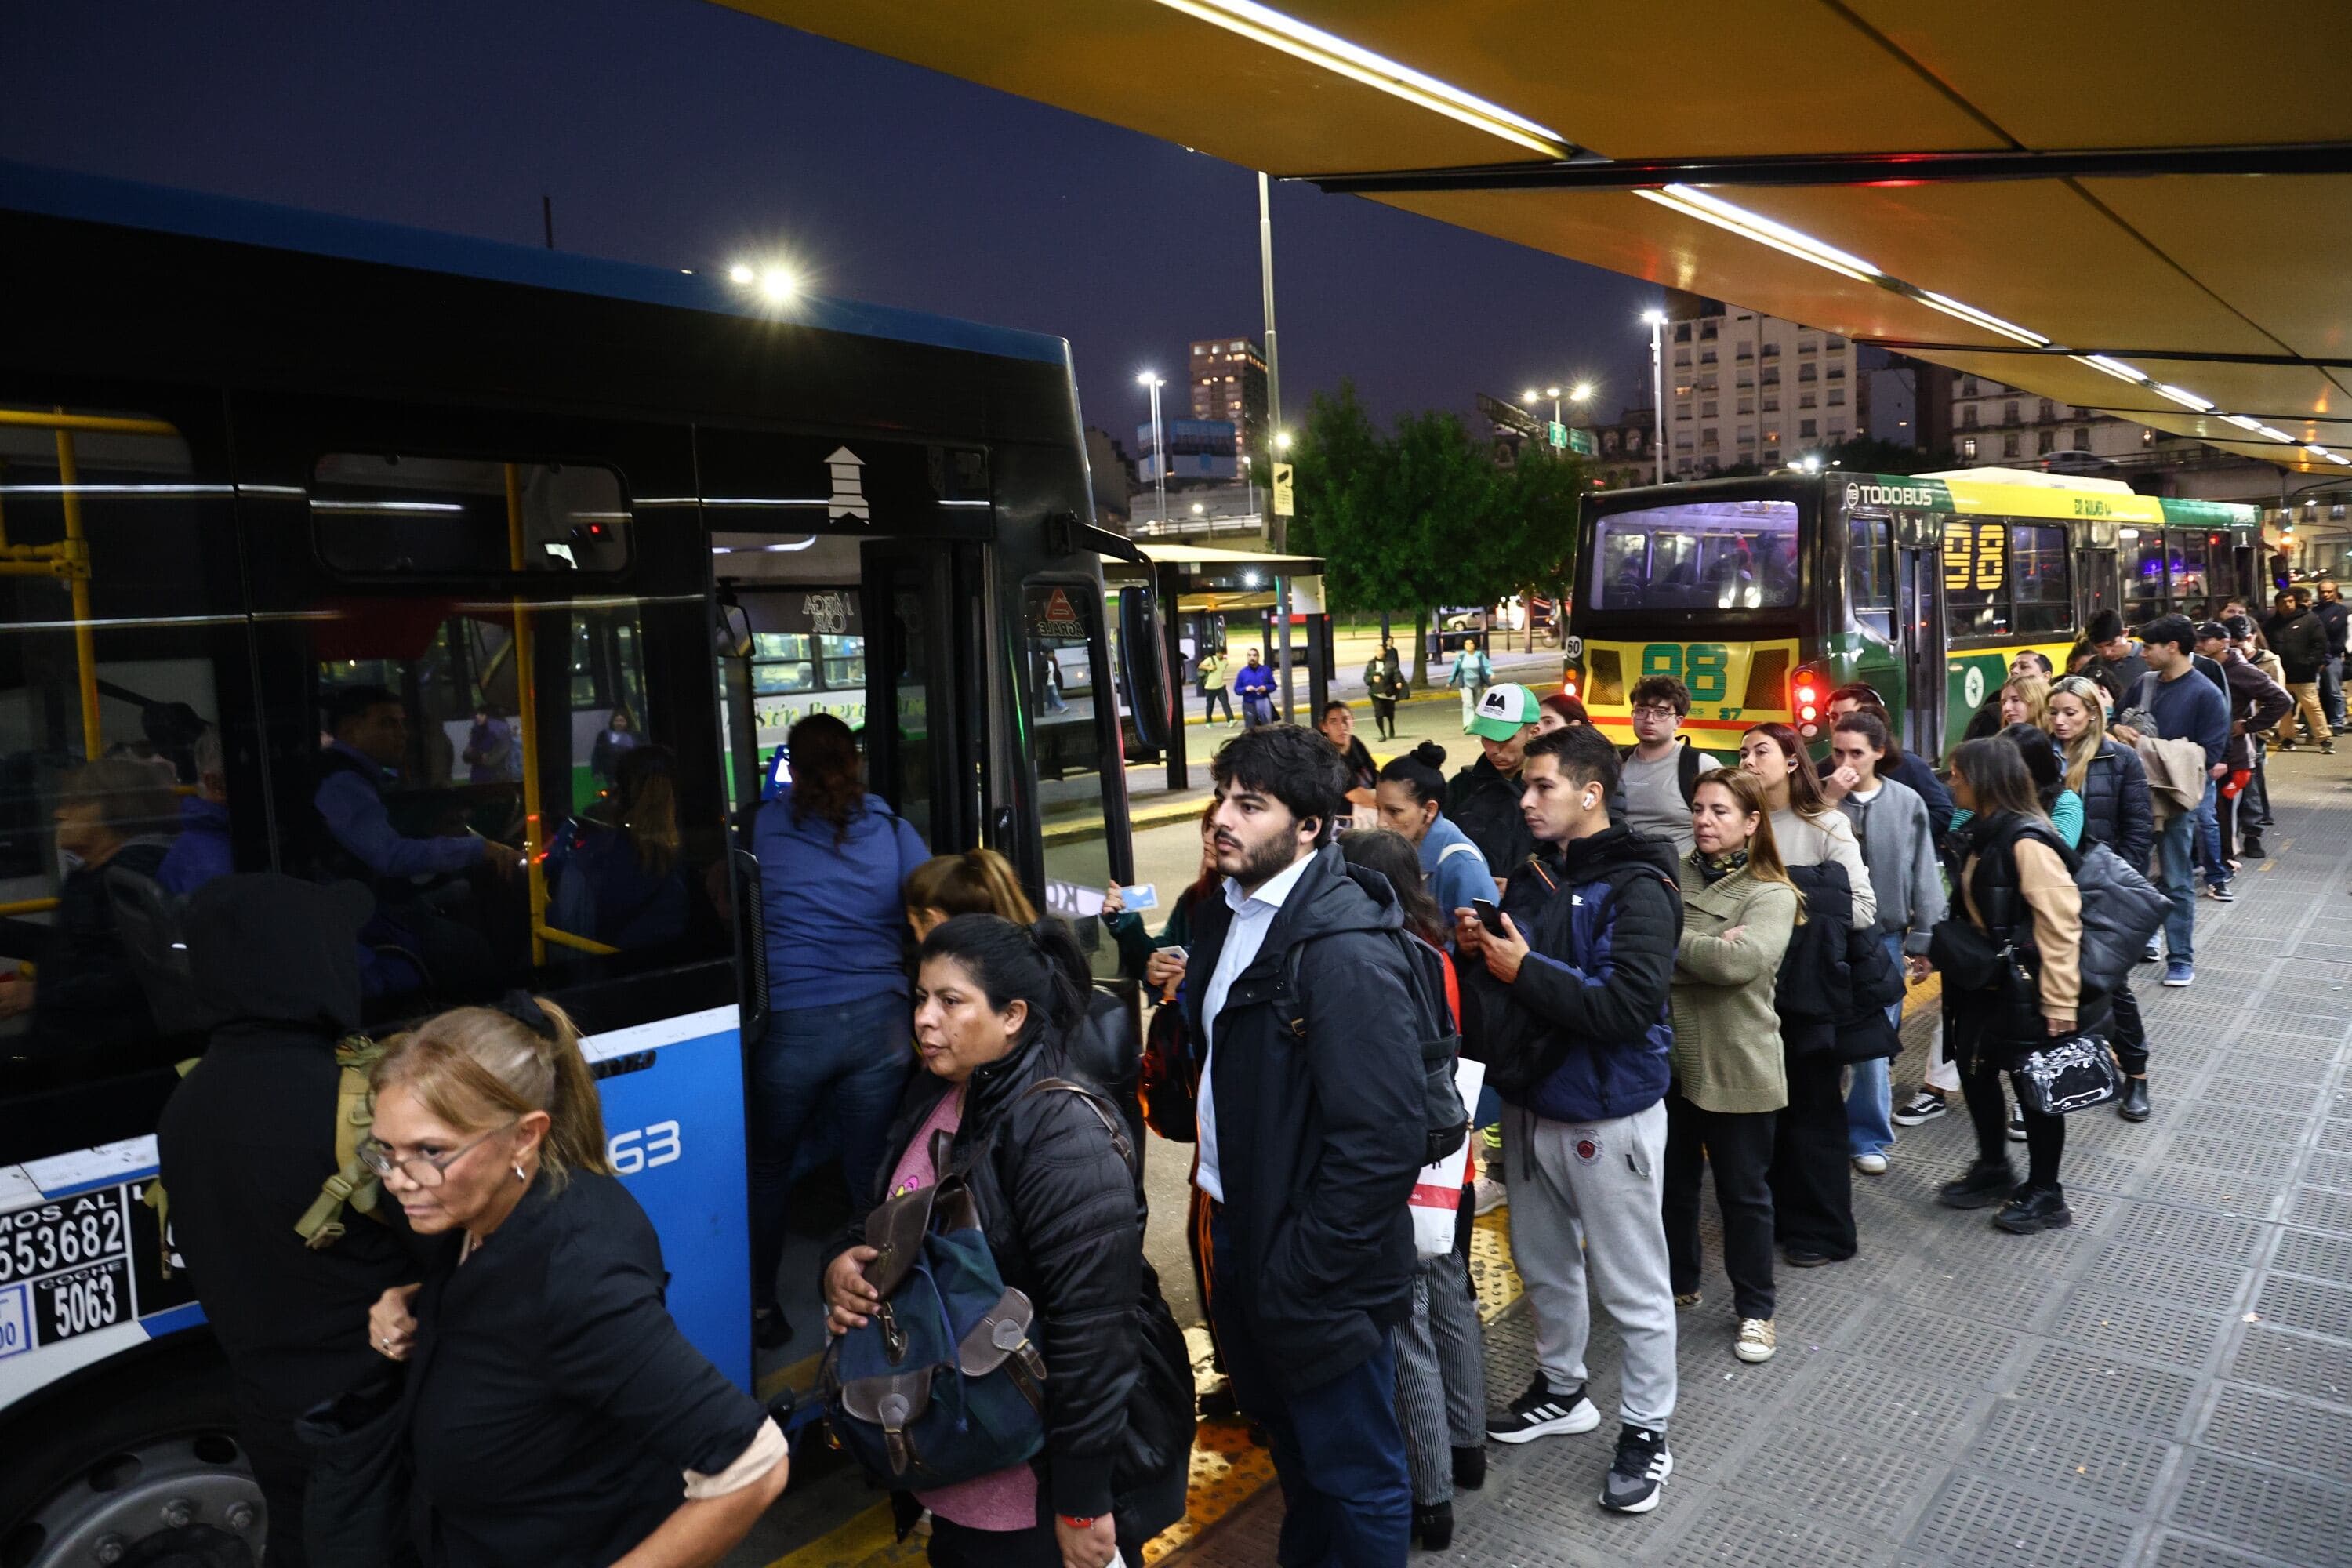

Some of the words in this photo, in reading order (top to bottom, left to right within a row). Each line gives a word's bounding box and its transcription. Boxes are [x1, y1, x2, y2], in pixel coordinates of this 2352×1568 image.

[1860, 485, 1933, 506] TODOBUS
[1944, 524, 2005, 590] 98
[1567, 640, 1580, 654] 60
[1642, 644, 1728, 702] 98
[608, 1120, 681, 1174] 63
[73, 1193, 117, 1215] AL
[39, 1261, 121, 1290] COCHE
[54, 1274, 117, 1338] 5063
